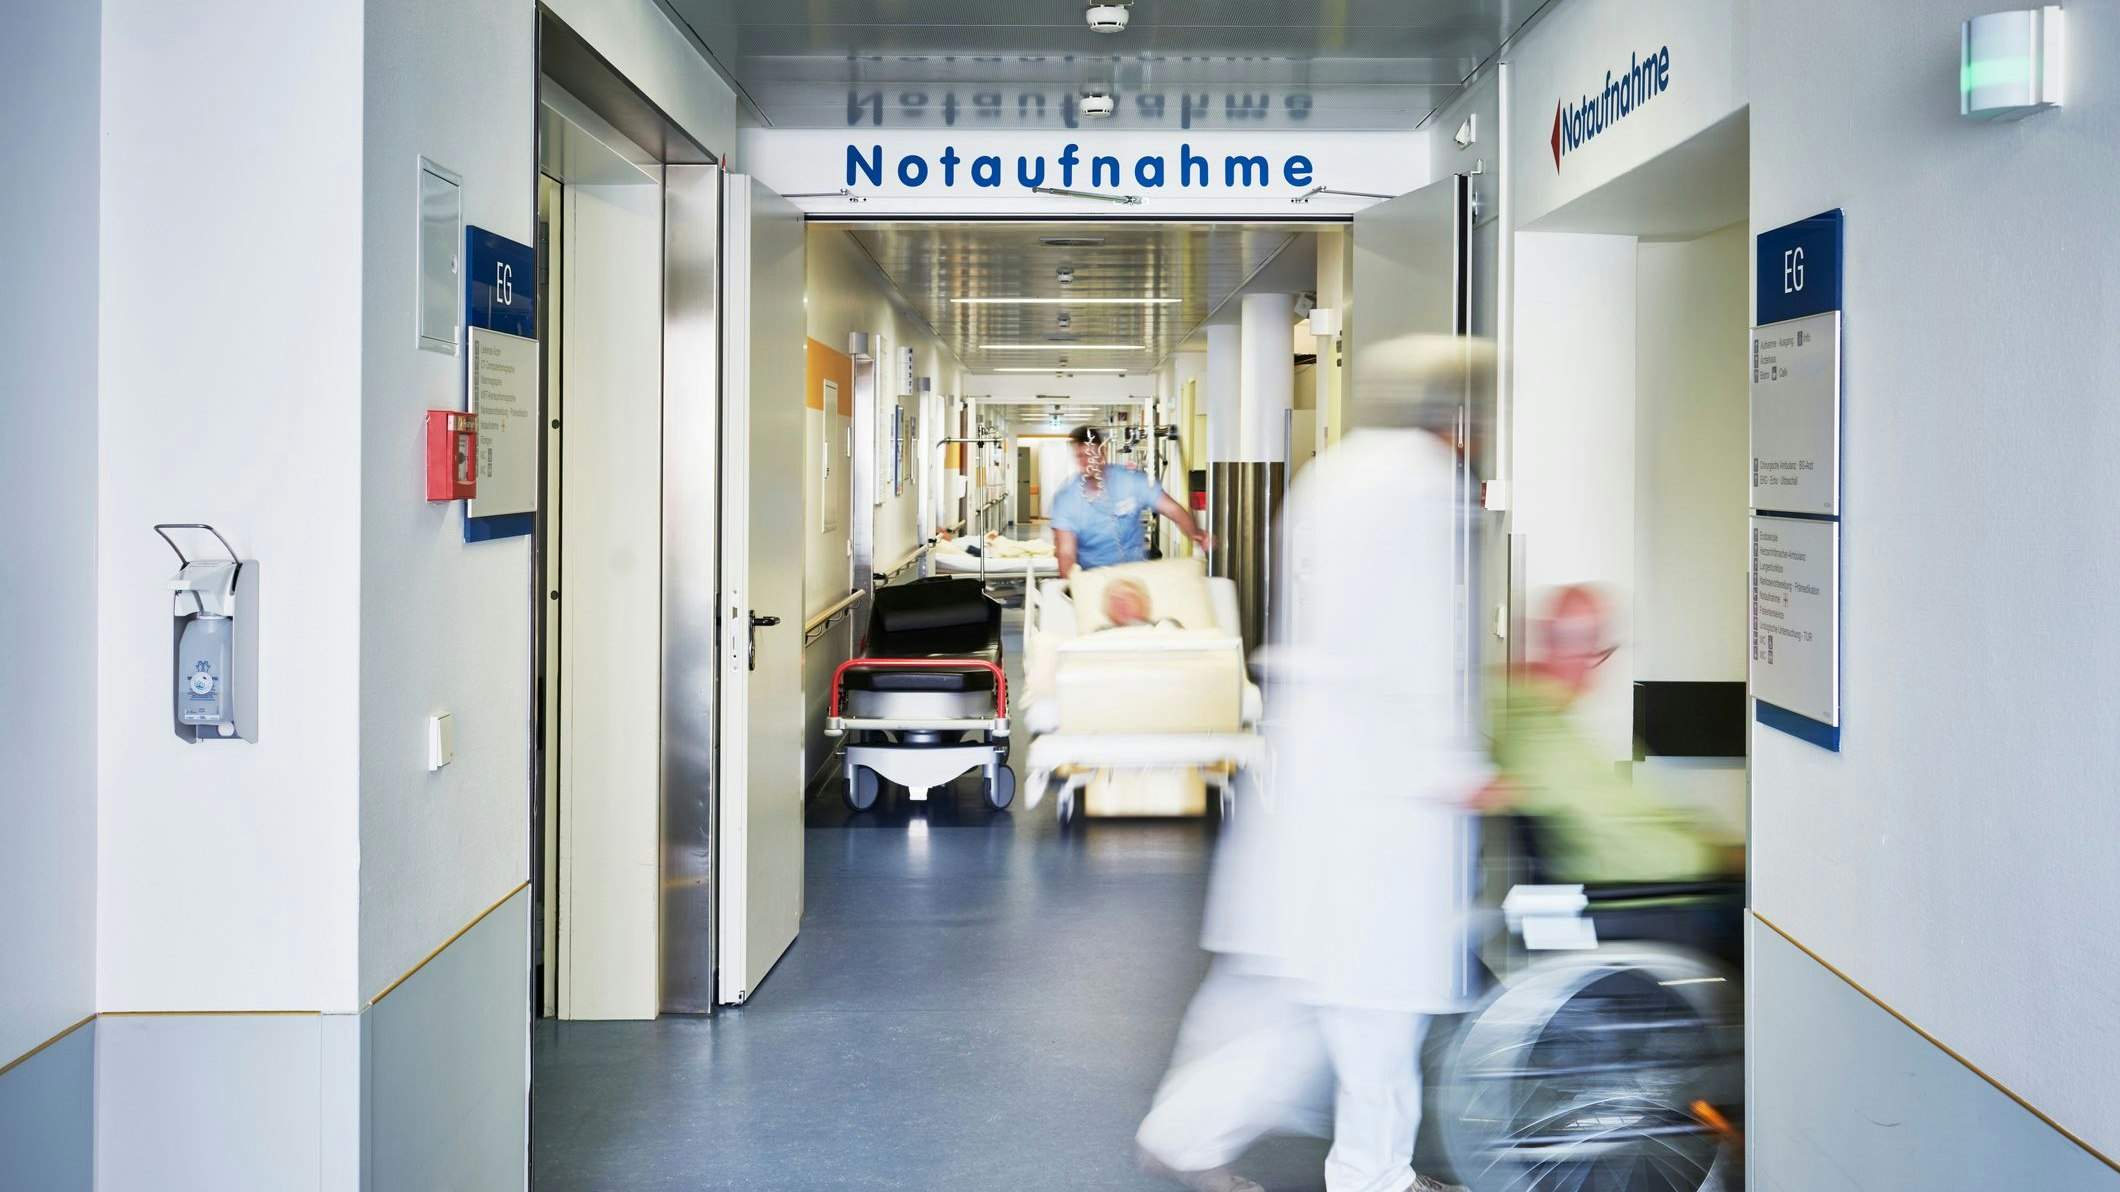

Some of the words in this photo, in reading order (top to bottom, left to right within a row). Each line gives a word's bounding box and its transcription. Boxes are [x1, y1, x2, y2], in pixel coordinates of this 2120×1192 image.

[1562, 45, 1669, 157] Notaufnahme
[846, 143, 1314, 188] Notaufnahme
[496, 261, 512, 306] EG
[1784, 246, 1804, 294] EG
